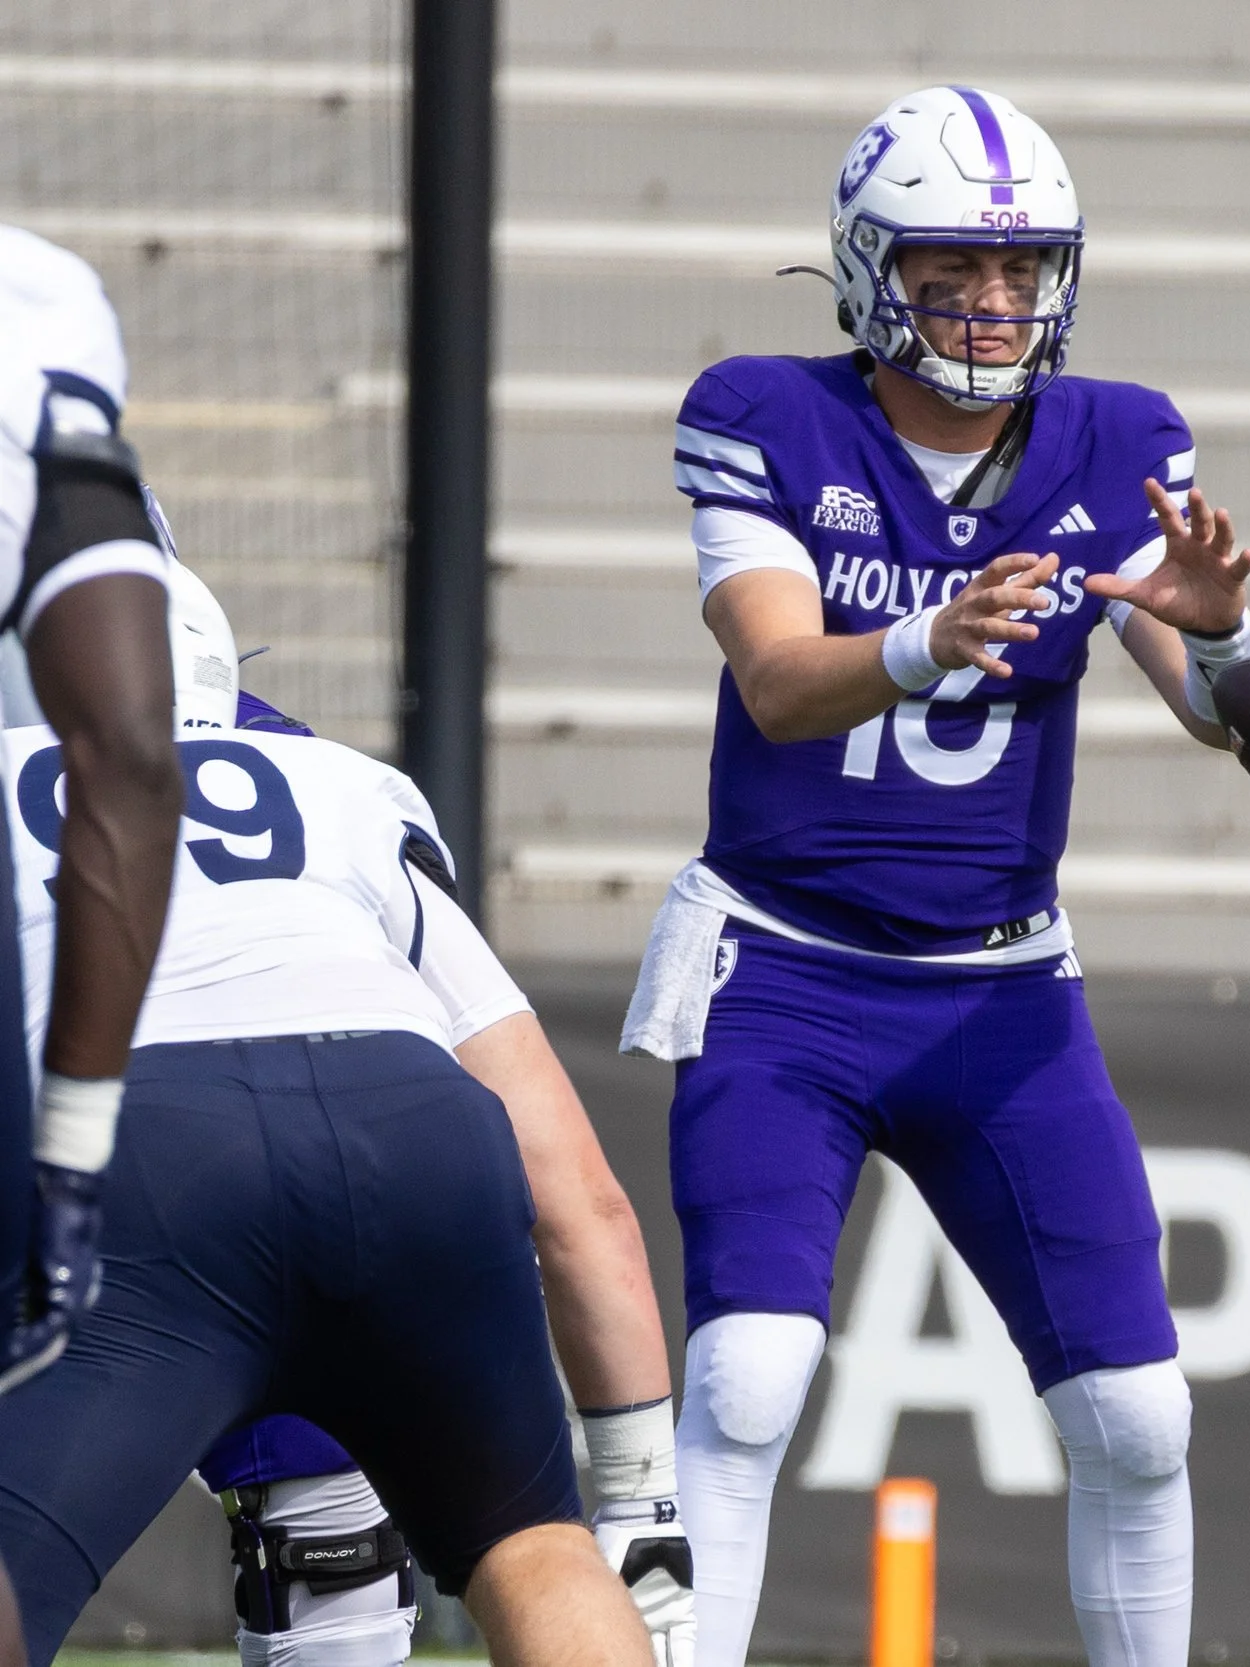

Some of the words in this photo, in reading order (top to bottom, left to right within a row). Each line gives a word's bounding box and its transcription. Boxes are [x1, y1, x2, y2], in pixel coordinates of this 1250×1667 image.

[981, 211, 1029, 229] 508
[811, 514, 880, 537] LEAGUE
[814, 504, 881, 526] PATRIOT
[823, 551, 935, 617] HOLY
[940, 565, 1087, 621] CSS
[304, 1548, 357, 1560] DONJOY
